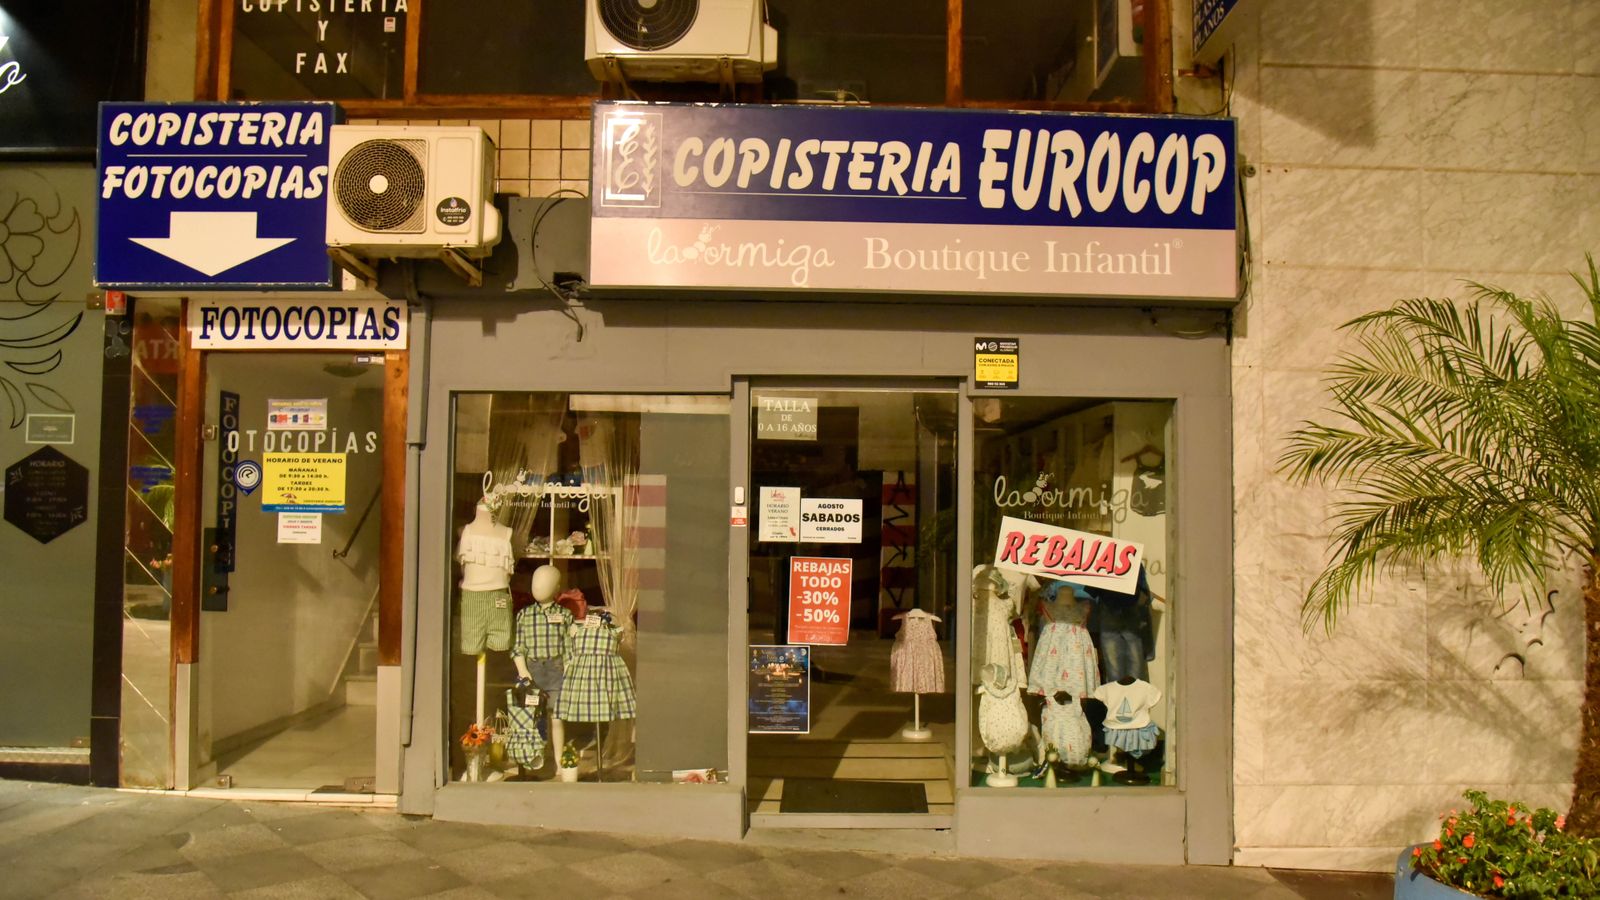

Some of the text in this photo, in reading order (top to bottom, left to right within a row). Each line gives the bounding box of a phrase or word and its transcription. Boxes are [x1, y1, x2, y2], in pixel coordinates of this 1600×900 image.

[317, 20, 329, 41] Y
[295, 52, 348, 74] FAX
[109, 111, 323, 147] COPISTERIA
[674, 136, 962, 196] COPISTERIA
[979, 129, 1227, 219] EUROCOP
[102, 165, 327, 200] FOTOCOPIAS
[863, 237, 1030, 280] Boutique
[199, 306, 400, 341] FOTOCOPIAS
[764, 399, 811, 413] TALLA
[781, 414, 792, 422] DE
[766, 424, 774, 432] A
[777, 424, 788, 432] 16
[790, 423, 817, 433] AÑOS
[801, 513, 861, 523] SABADOS
[1023, 511, 1066, 522] Boutique
[1000, 531, 1137, 576] REBAJAS
[793, 561, 850, 576] REBAJAS
[800, 576, 842, 589] TODO
[796, 591, 839, 606] -30%
[796, 609, 840, 624] -50%
